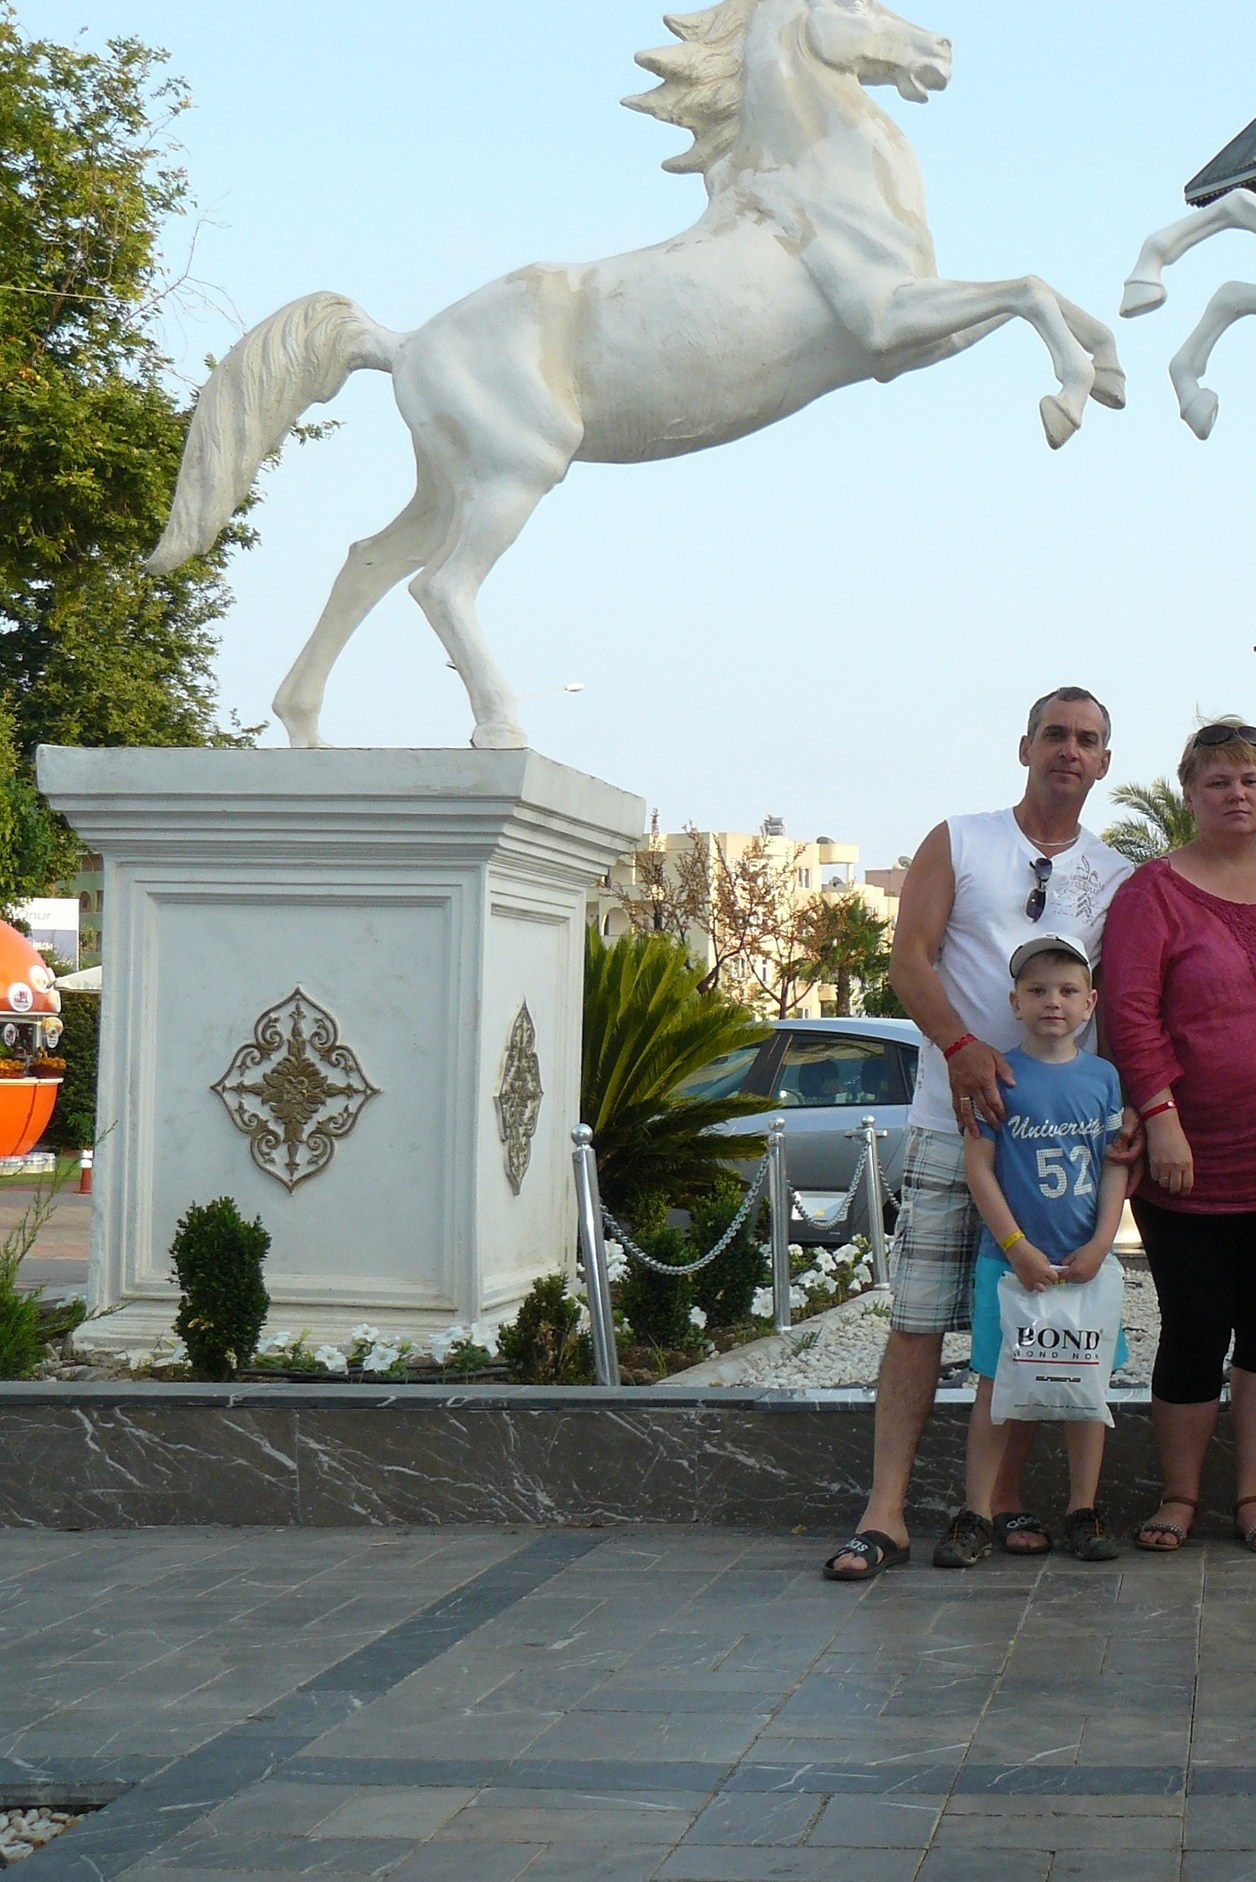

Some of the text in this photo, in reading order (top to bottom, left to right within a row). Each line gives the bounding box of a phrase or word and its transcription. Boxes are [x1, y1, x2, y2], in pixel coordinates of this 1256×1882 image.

[1008, 1114, 1105, 1140] University
[1036, 1145, 1093, 1199] 52
[1016, 1326, 1100, 1350] BOND
